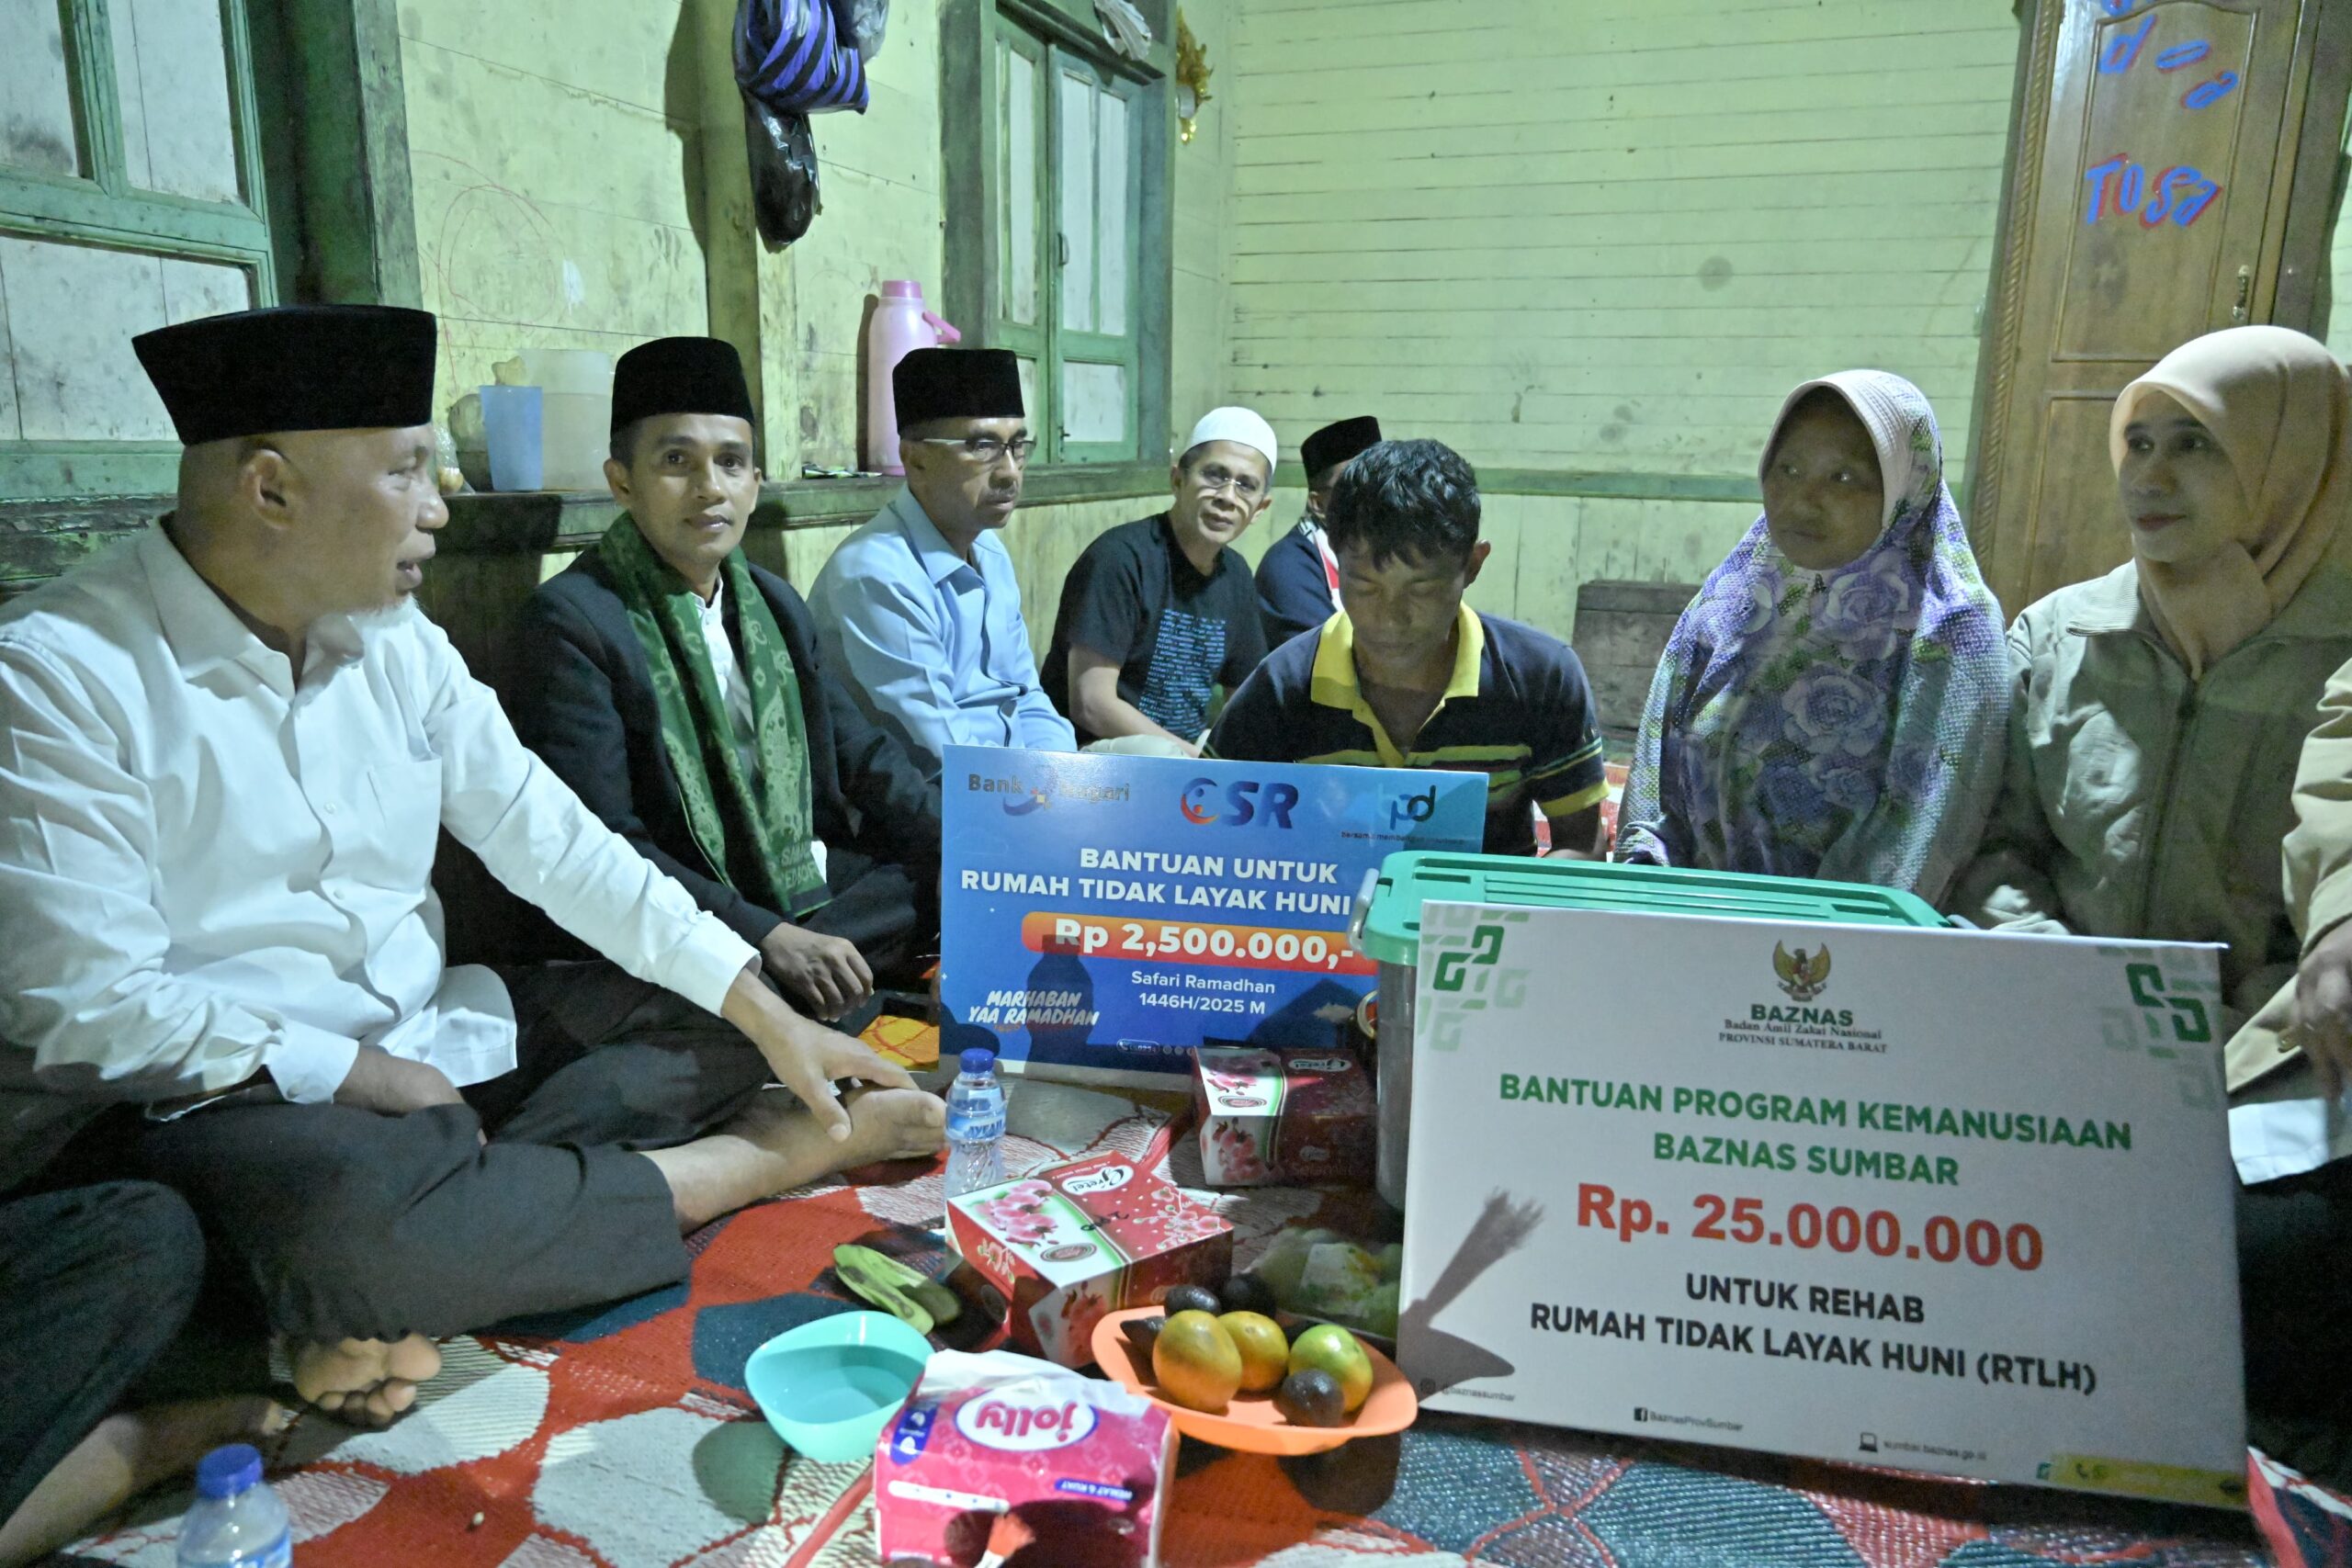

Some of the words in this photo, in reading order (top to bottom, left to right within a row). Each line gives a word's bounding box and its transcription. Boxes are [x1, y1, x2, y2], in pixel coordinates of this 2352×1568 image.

[968, 774, 1023, 794] Bank
[1060, 782, 1130, 804] agari
[1181, 778, 1298, 829] CSR
[1080, 848, 1224, 877] BANTUAN
[1234, 858, 1339, 884] UNTUK
[961, 870, 1069, 897] RUMAH
[1079, 878, 1166, 904] TIDAK
[1174, 885, 1267, 911] LAYAK
[1275, 891, 1351, 916] HUNI
[1056, 919, 1109, 954] Rp
[1121, 923, 1354, 970] 2,500.000,-
[986, 990, 1082, 1008] MARHABAN
[1131, 971, 1181, 987] Safari
[1185, 974, 1276, 994] Ramadhan
[967, 1006, 1000, 1023] YAA
[1003, 1007, 1100, 1026] RAMADHAN
[1138, 992, 1245, 1013] 1446H/2025
[1250, 1000, 1266, 1015] M
[1750, 1004, 1854, 1027] BAZNAS
[1718, 1032, 1776, 1046] PROVINSI
[1779, 1036, 1844, 1051] SUMATERA
[1847, 1042, 1889, 1054] BARAT
[1724, 1019, 1760, 1031] Badan
[1764, 1021, 1792, 1033] Amil
[1794, 1024, 1826, 1036] Zakat
[1830, 1026, 1883, 1040] Nasional
[1499, 1073, 1662, 1112] BANTUAN
[1673, 1087, 1846, 1127] PROGRAM
[1858, 1100, 2132, 1151] KEMANUSIAAN
[1654, 1132, 1797, 1171] BAZNAS
[1806, 1145, 1960, 1186] SUMBAR
[1067, 1168, 1125, 1192] Gretel
[1577, 1182, 1670, 1243] Rp.
[1691, 1193, 2043, 1271] 25.000.000
[1686, 1272, 1799, 1311] UNTUK
[1808, 1286, 1925, 1324] REHAB
[1530, 1303, 1645, 1342] RUMAH
[1655, 1316, 1754, 1354] TIDAK
[1763, 1328, 1872, 1367] LAYAK
[1882, 1342, 1966, 1378] HUNI
[1976, 1353, 2097, 1396] (RTLH)
[976, 1401, 1078, 1442] jolly
